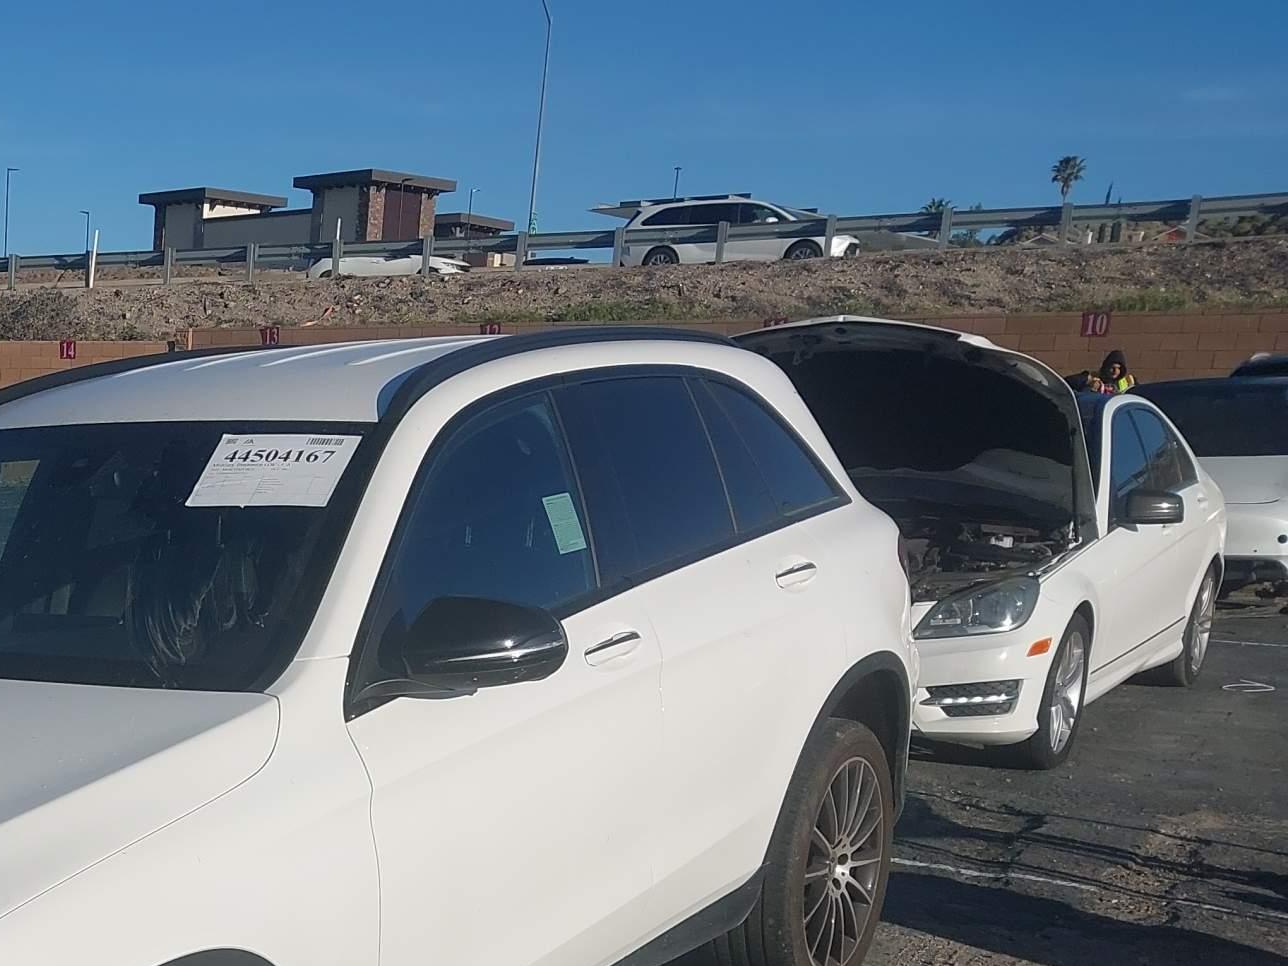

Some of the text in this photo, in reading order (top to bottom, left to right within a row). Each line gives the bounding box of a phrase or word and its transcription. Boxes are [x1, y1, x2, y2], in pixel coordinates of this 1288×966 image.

[1085, 314, 1108, 336] 10
[265, 327, 279, 345] 13
[62, 341, 75, 358] 14
[223, 449, 336, 464] 44504167
